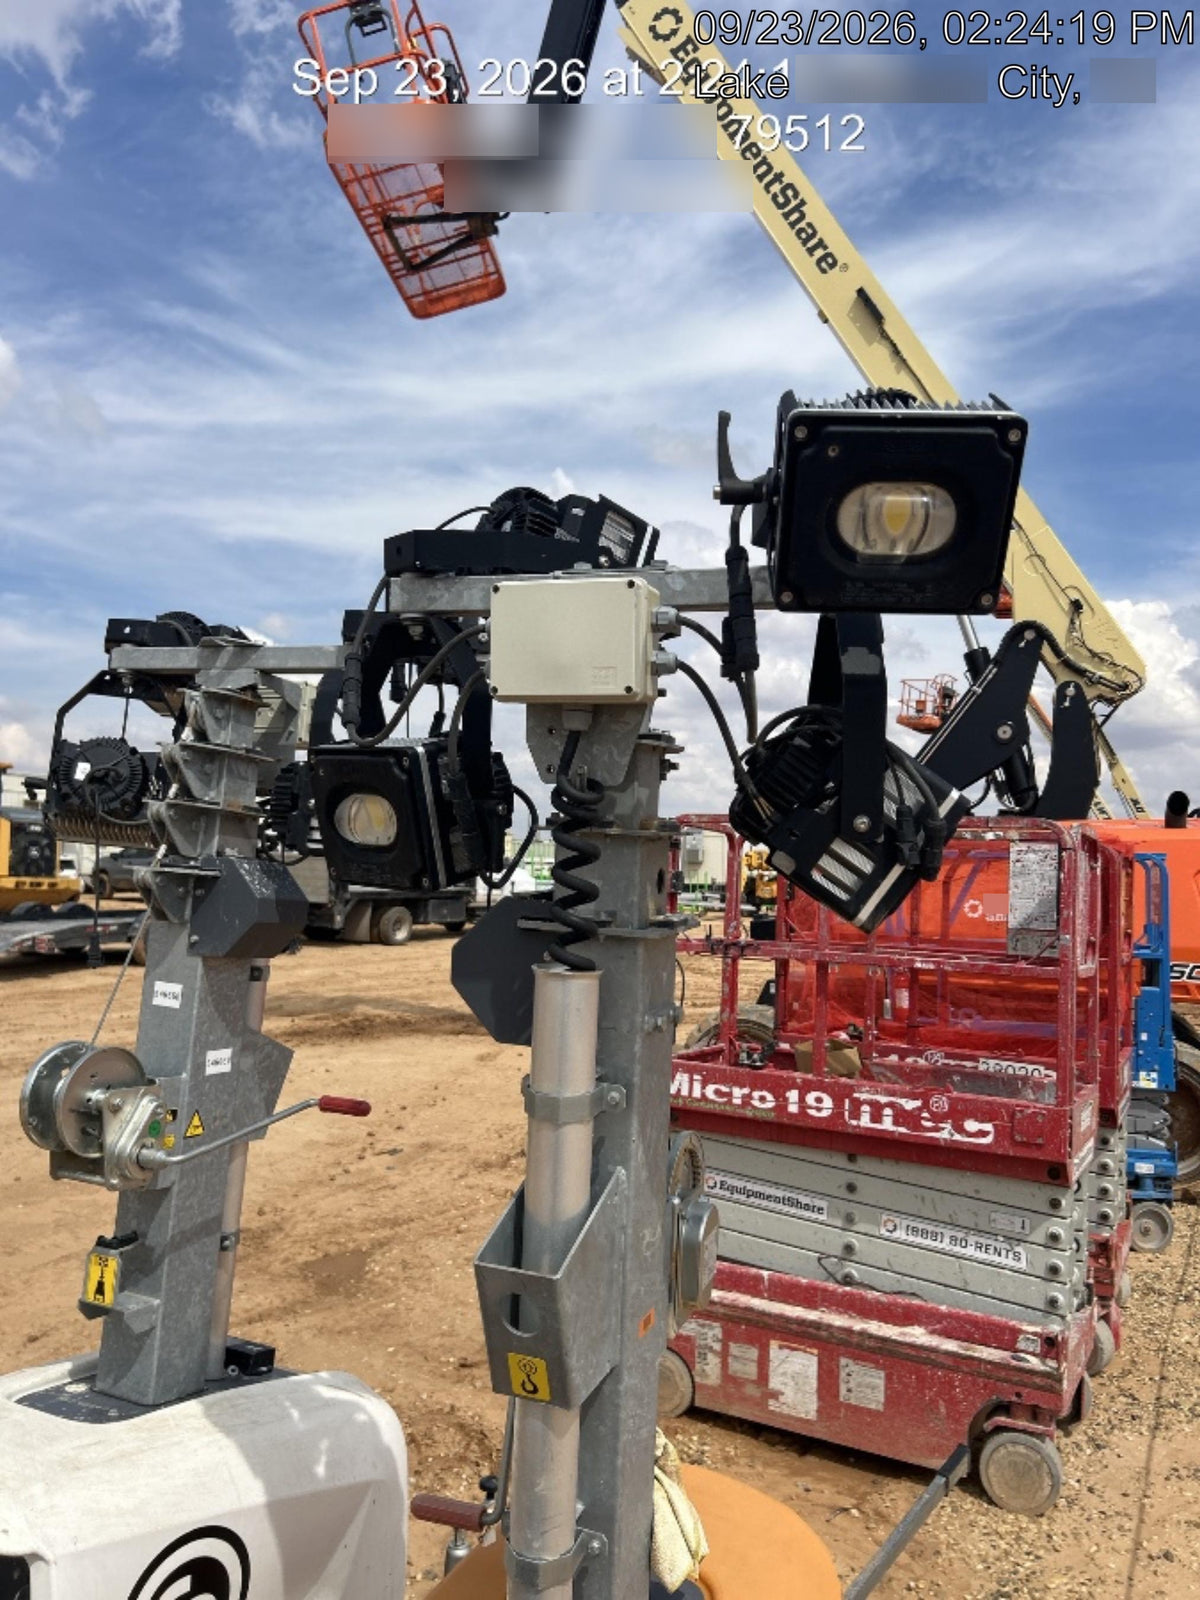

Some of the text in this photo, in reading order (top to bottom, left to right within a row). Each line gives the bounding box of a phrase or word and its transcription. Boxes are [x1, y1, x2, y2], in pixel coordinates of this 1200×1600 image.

[669, 1069, 776, 1109] Micro
[785, 1089, 833, 1118] 19
[719, 1180, 825, 1215] EquipmentShare
[949, 1235, 1022, 1263] 80-RENTS
